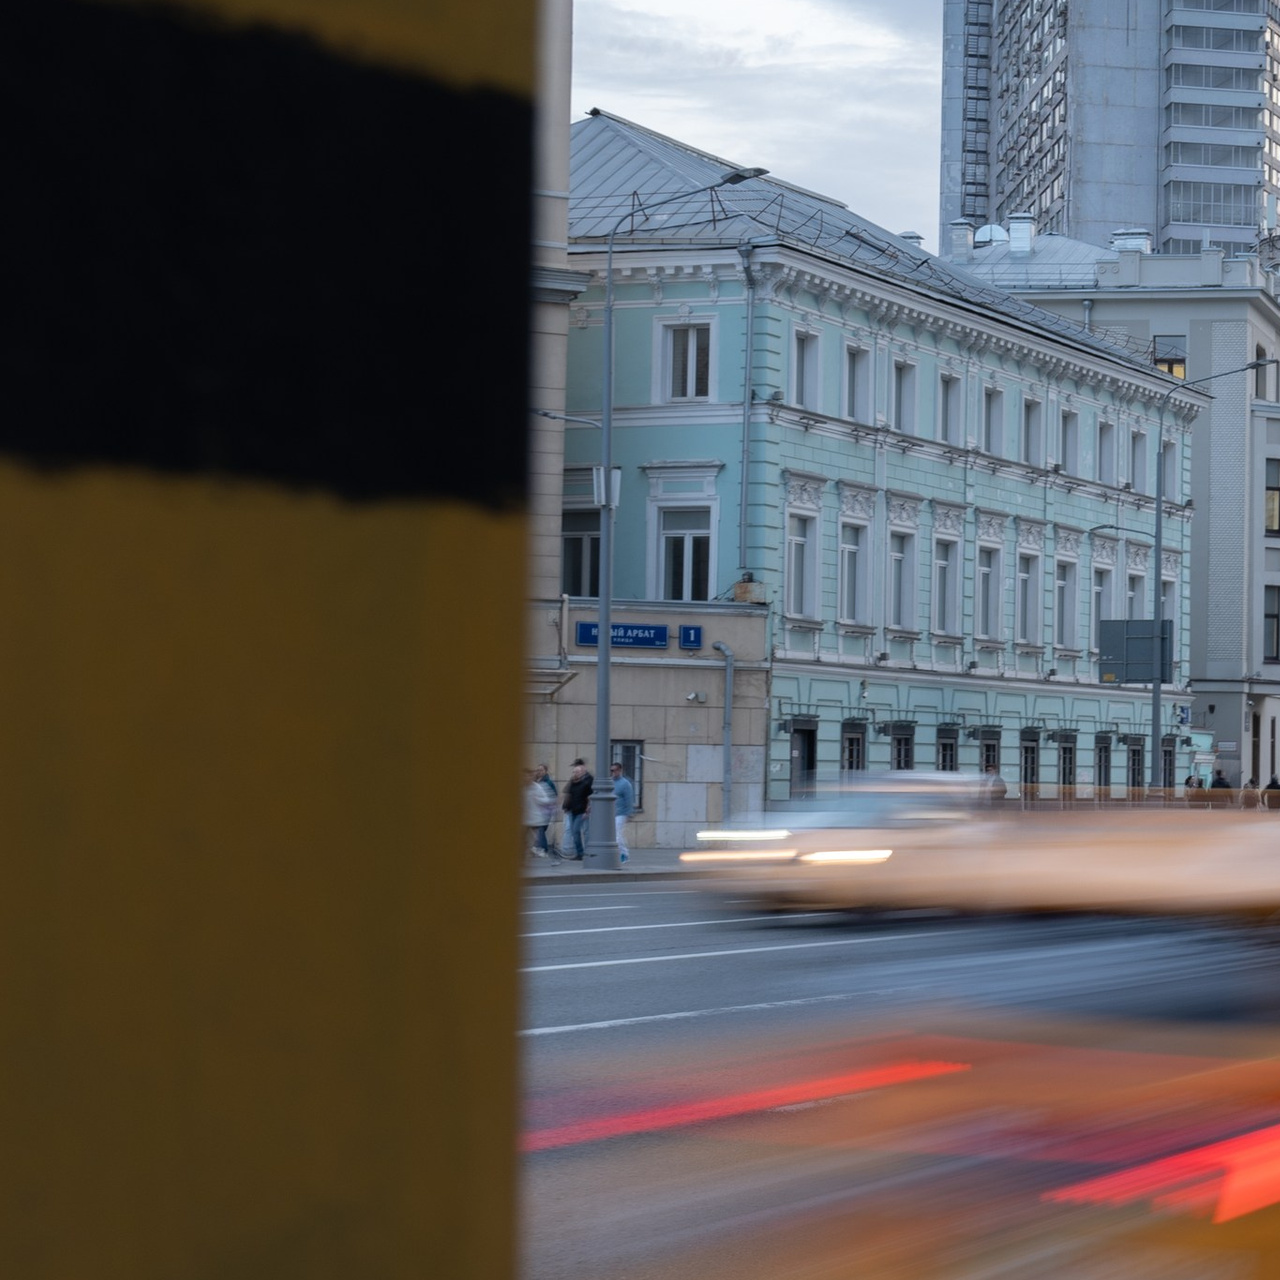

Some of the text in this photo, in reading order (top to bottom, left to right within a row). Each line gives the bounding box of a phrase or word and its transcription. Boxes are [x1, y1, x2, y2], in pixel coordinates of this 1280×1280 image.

[591, 627, 656, 639] НЫЙ АРБАТ
[689, 629, 695, 641] 1
